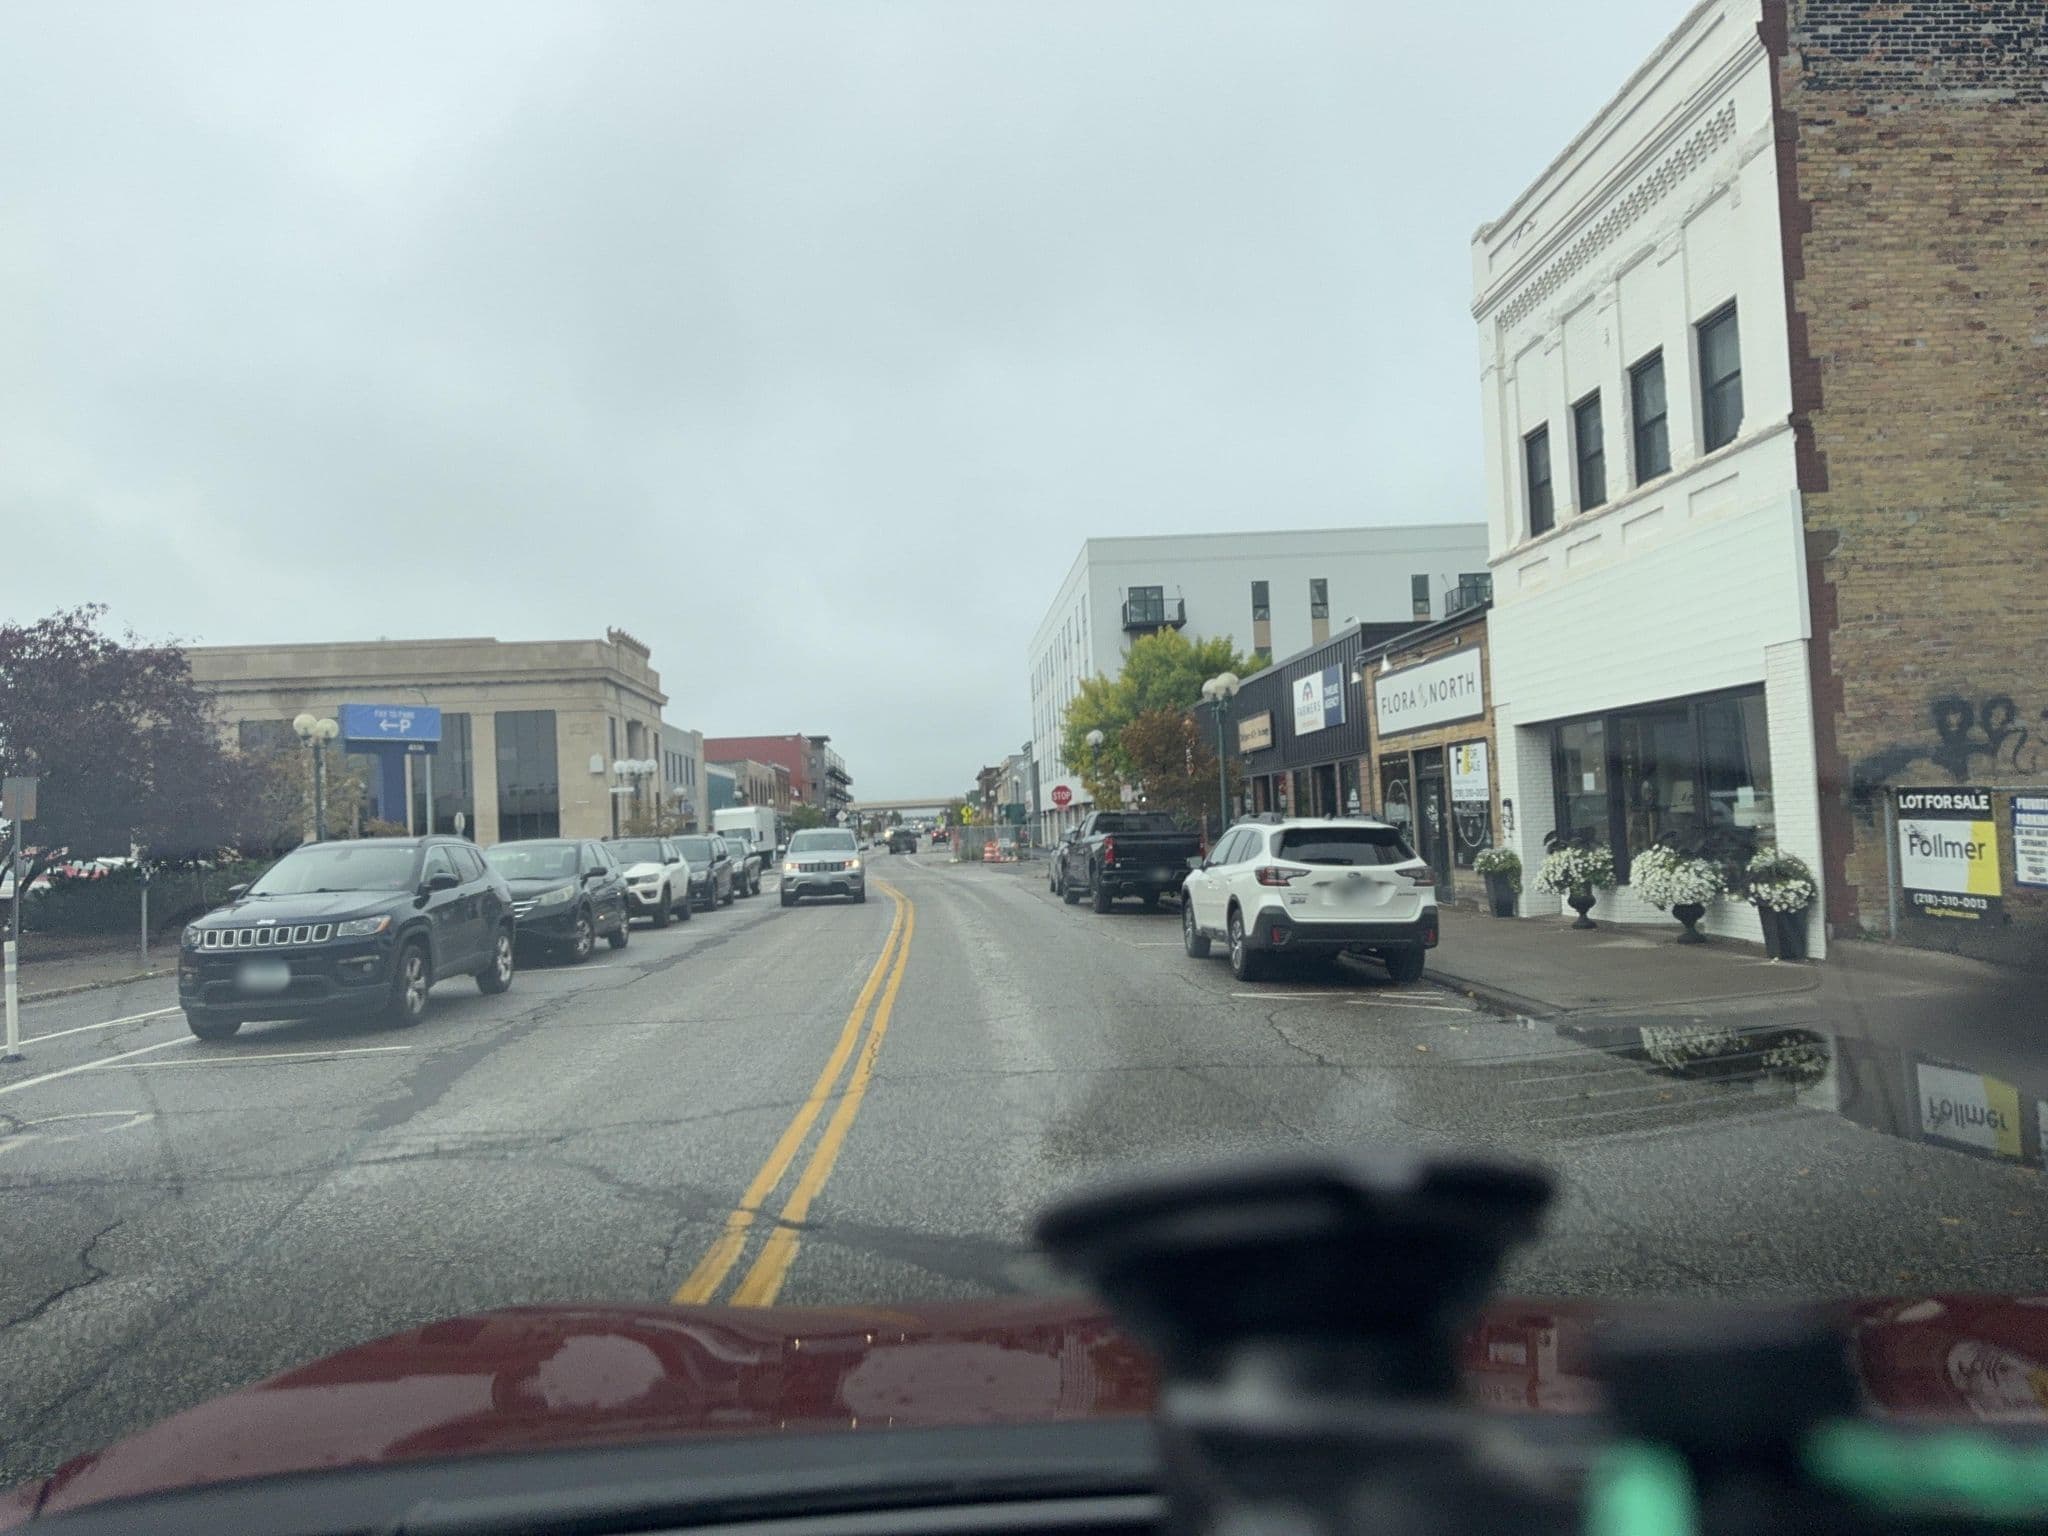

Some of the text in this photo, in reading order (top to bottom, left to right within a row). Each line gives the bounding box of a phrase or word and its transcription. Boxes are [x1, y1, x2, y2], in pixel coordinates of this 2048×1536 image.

[1381, 672, 1475, 715] FLORA NORTH
[1052, 791, 1070, 800] STOP
[1899, 795, 1990, 809] LOT FOR SALE
[1909, 832, 1986, 860] Follmer
[1914, 893, 1987, 909] (218)-310-0013
